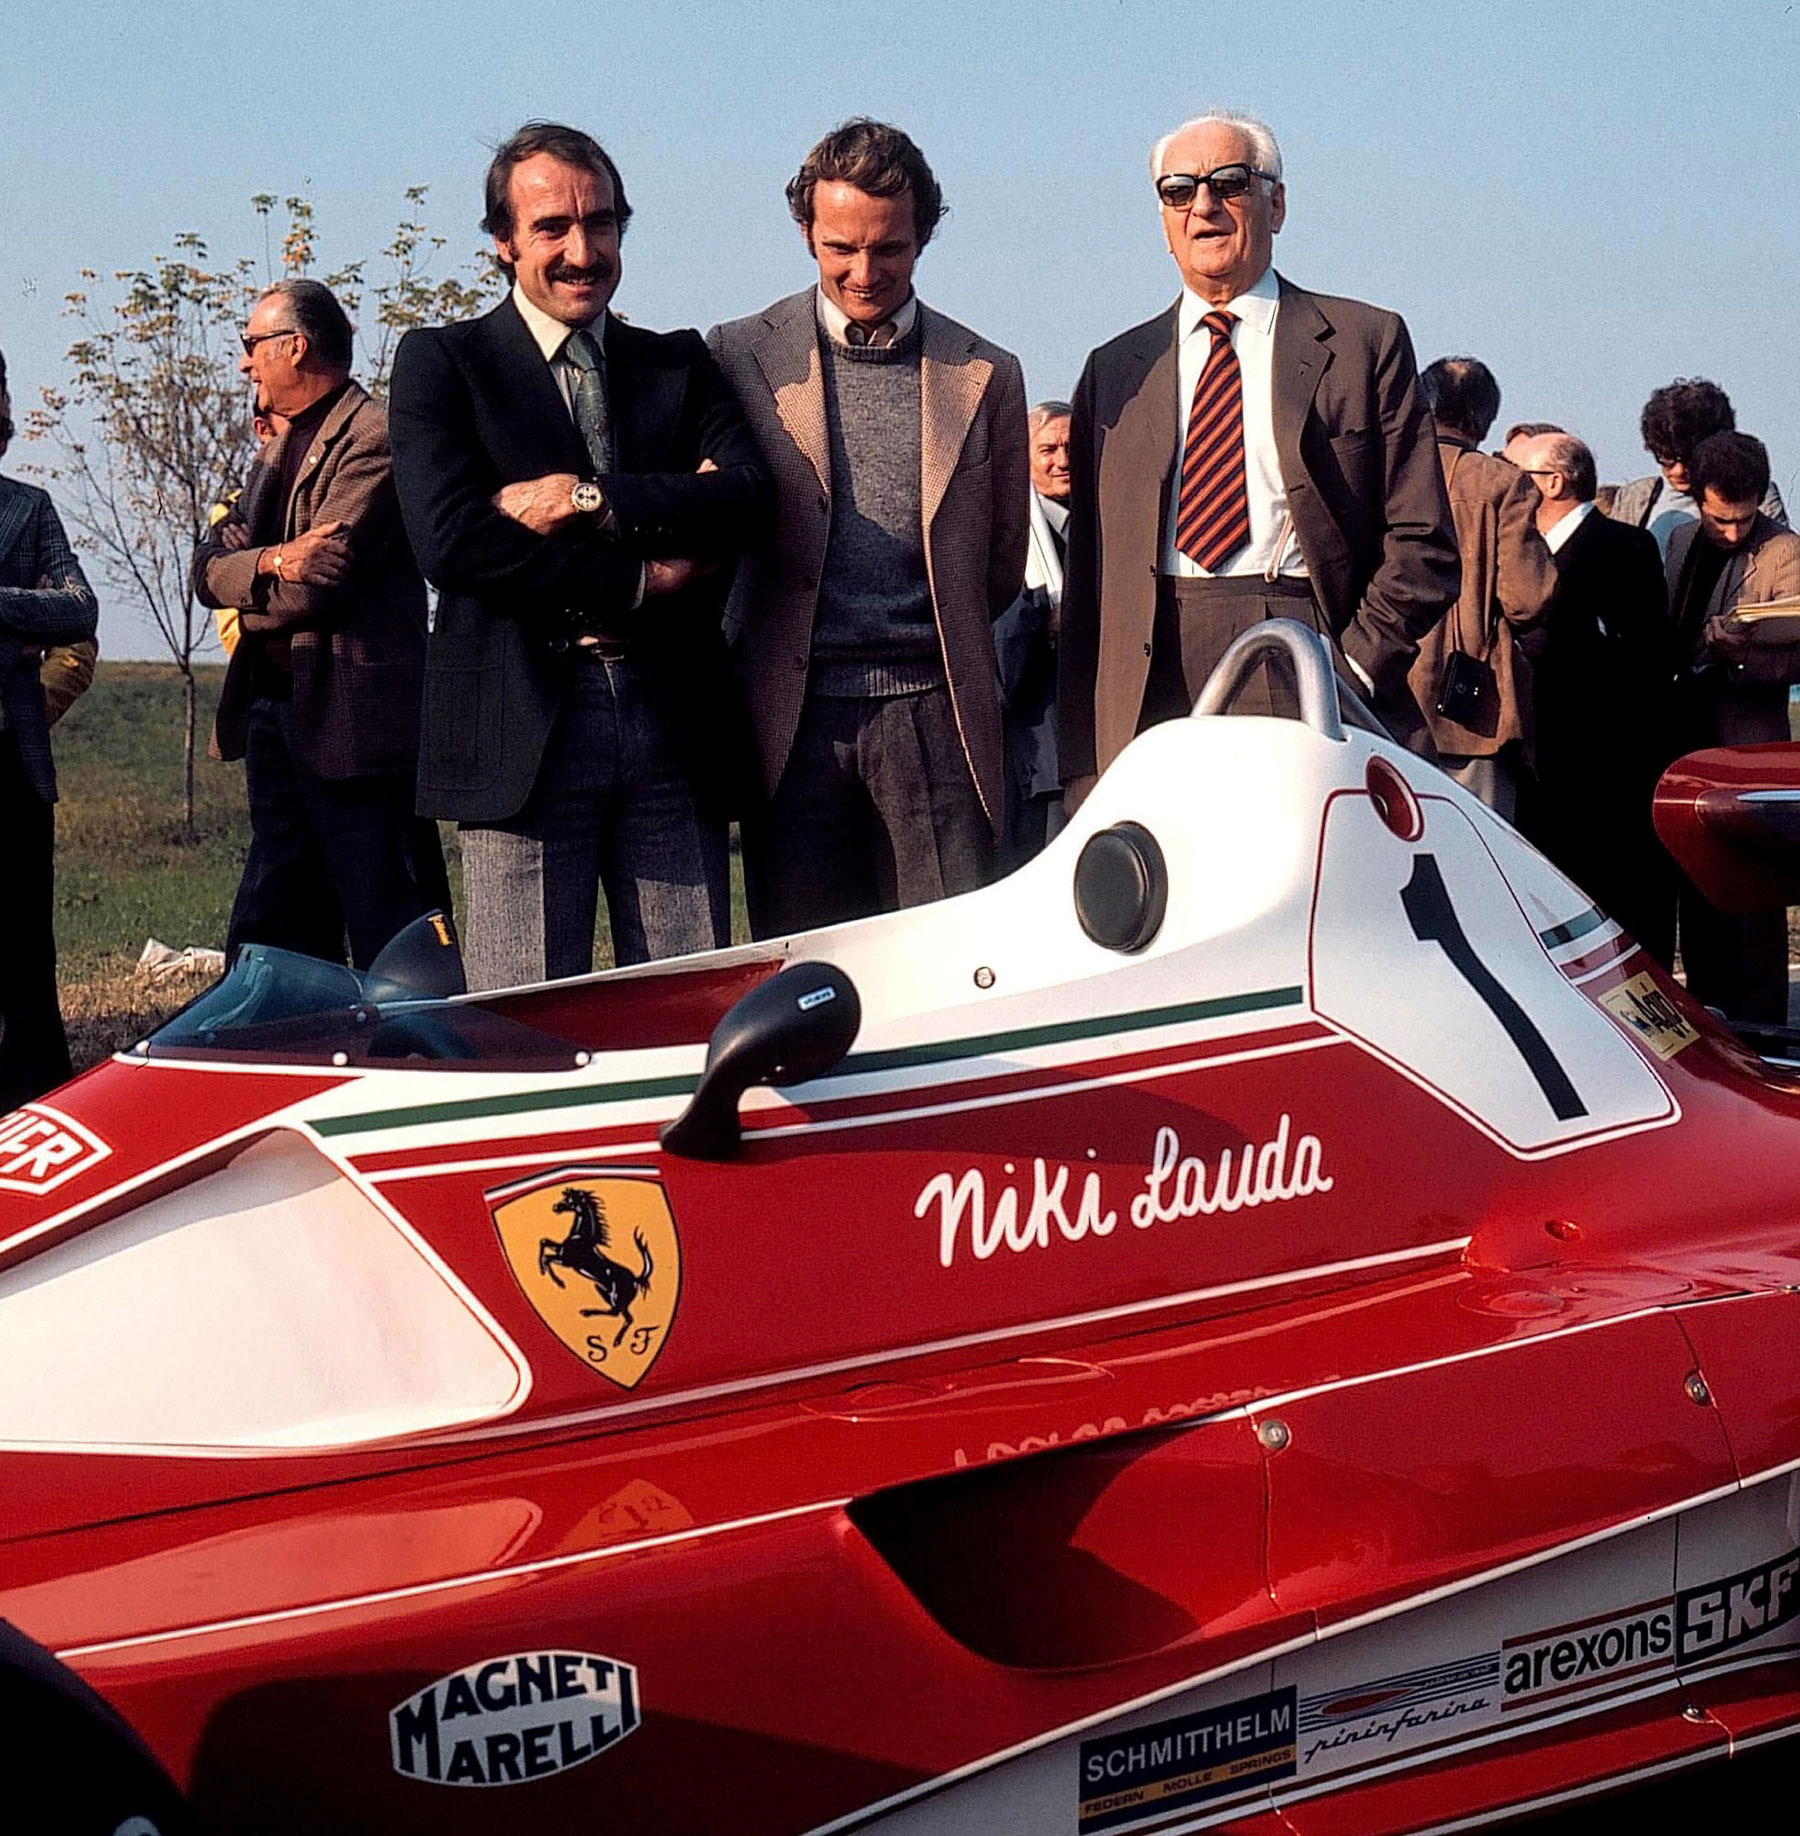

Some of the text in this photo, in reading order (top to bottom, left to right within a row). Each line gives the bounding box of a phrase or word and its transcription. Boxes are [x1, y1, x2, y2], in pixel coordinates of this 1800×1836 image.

[1400, 853, 1590, 1122] 1
[1130, 1113, 1334, 1229] Lauda
[586, 1335, 608, 1363] S
[1683, 1557, 1800, 1655] SKF
[1504, 1613, 1672, 1695] arexons
[395, 1655, 637, 1780] MAGNETI
[395, 1665, 637, 1783] MARELLI
[1085, 1704, 1291, 1783] SCHMITTHELM
[1304, 1697, 1491, 1764] pininfarina
[1084, 1750, 1292, 1813] FEDERN MOLLE SPRINGS
